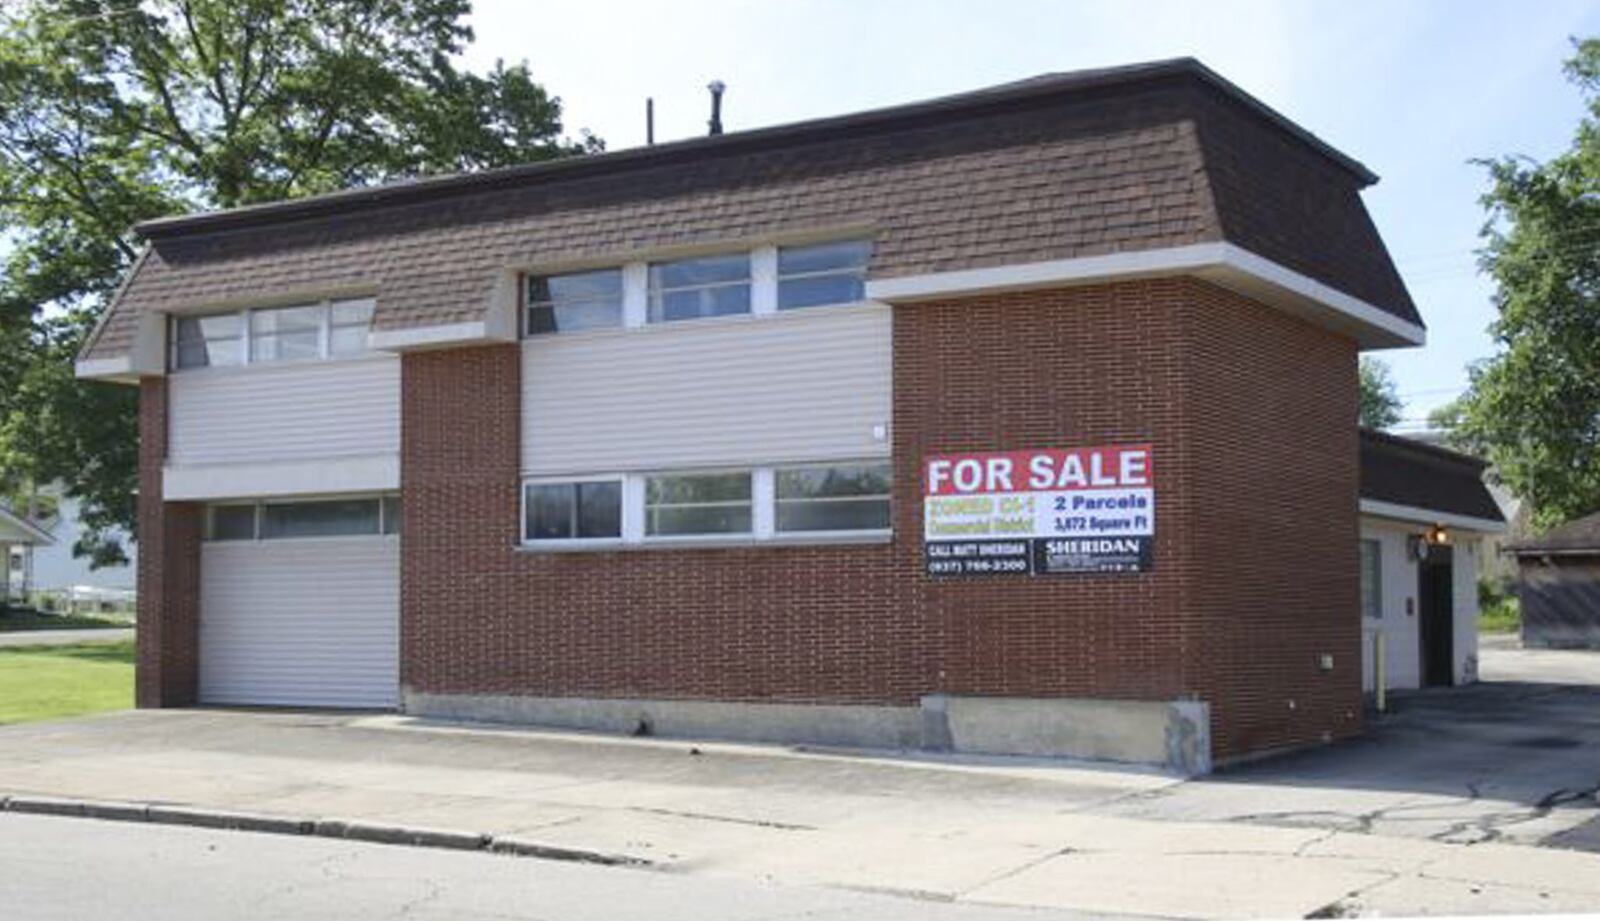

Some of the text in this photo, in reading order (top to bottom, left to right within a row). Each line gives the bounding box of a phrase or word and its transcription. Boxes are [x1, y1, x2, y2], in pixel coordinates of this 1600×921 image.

[929, 451, 1147, 493] FOR SALE
[1053, 494, 1147, 511] 2 Parcels
[1088, 516, 1131, 532] Square
[1134, 515, 1148, 529] Ft
[1046, 539, 1140, 555] SHERIDAN
